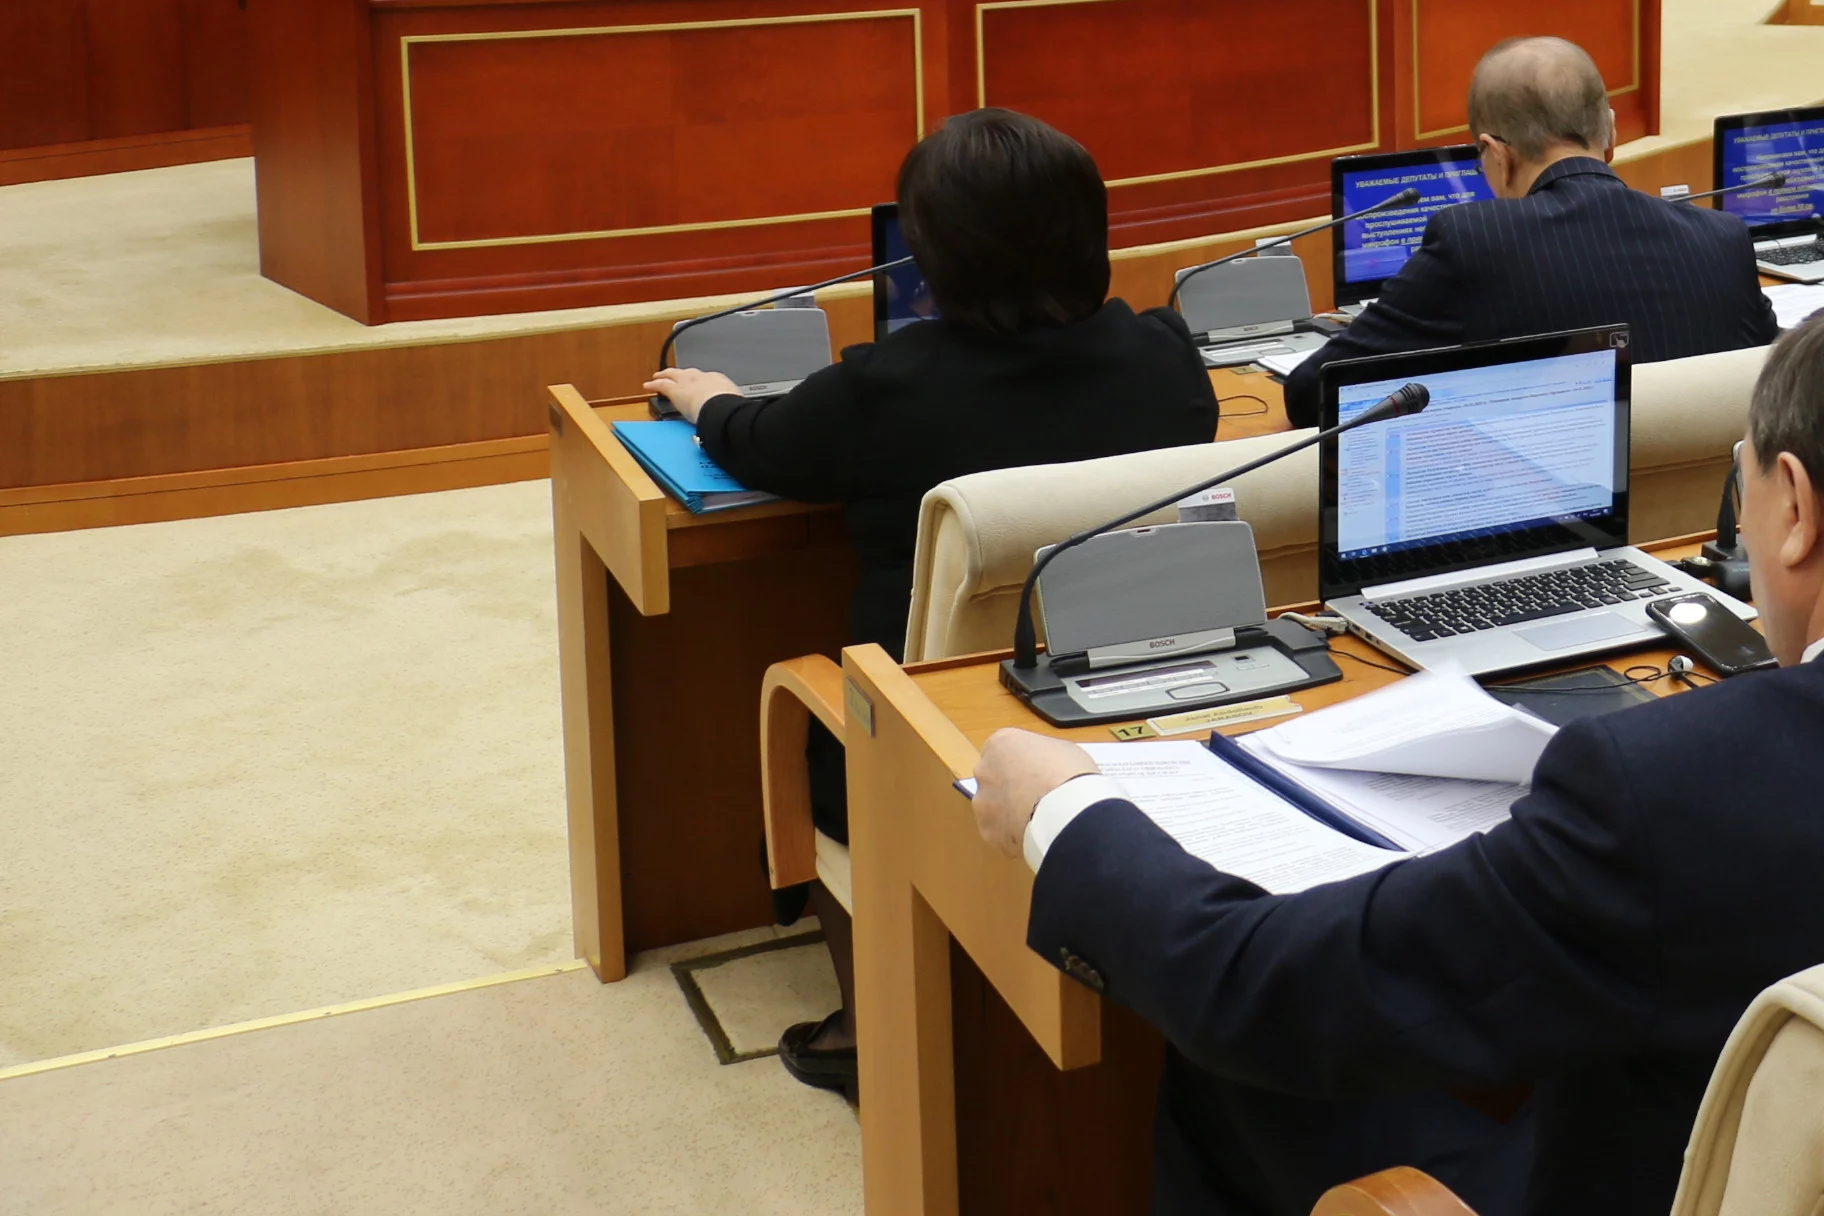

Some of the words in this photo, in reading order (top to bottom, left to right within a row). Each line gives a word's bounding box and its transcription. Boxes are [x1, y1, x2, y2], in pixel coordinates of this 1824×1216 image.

[1355, 177, 1400, 189] УВАЖАЕМЫЕ
[1401, 173, 1437, 184] ДЕПУТАТЫ
[1149, 639, 1175, 648] BOSCH
[1117, 725, 1145, 737] 17
